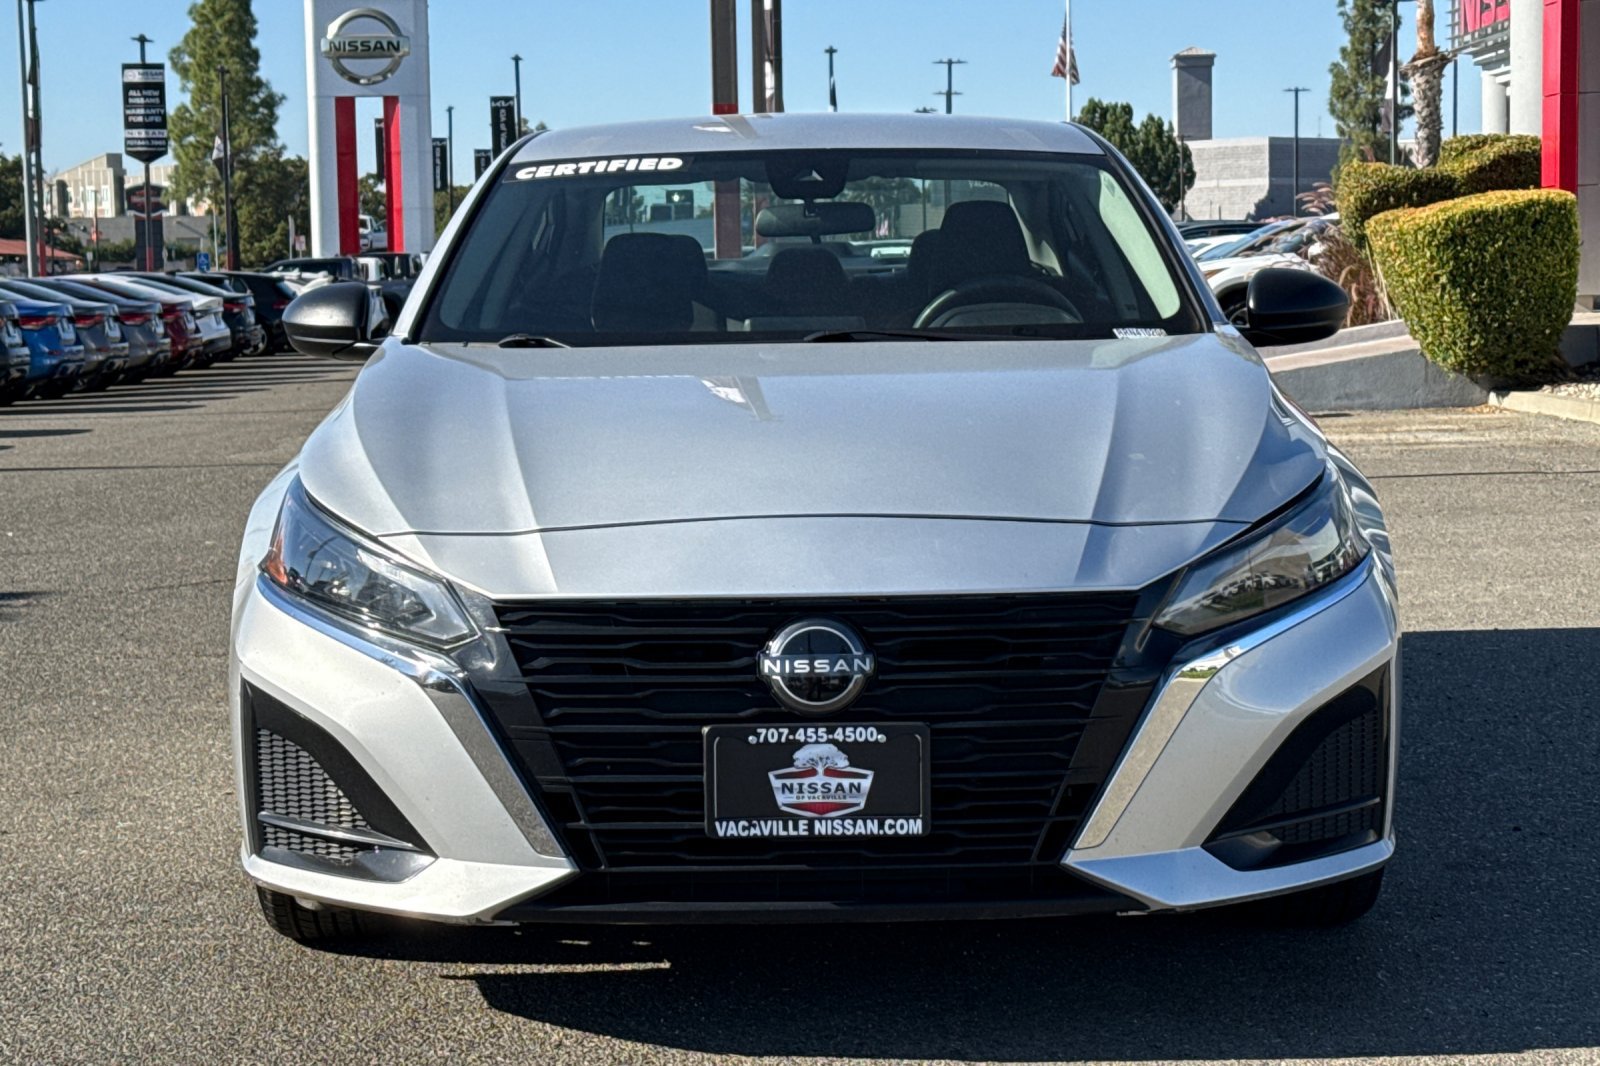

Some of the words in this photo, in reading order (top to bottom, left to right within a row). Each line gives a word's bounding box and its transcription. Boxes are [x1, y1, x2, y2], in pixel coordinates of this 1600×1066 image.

[329, 40, 401, 52] NISSAN
[128, 89, 141, 97] ALL
[142, 89, 160, 97] NEW
[128, 115, 143, 123] FOR
[515, 157, 683, 180] CERTIFIED
[764, 657, 871, 674] NISSAN
[756, 726, 877, 743] 707-455-4500
[781, 782, 862, 794] NISSAN
[715, 819, 809, 837] VACAVILLE
[814, 819, 923, 836] NISSAN.COM
